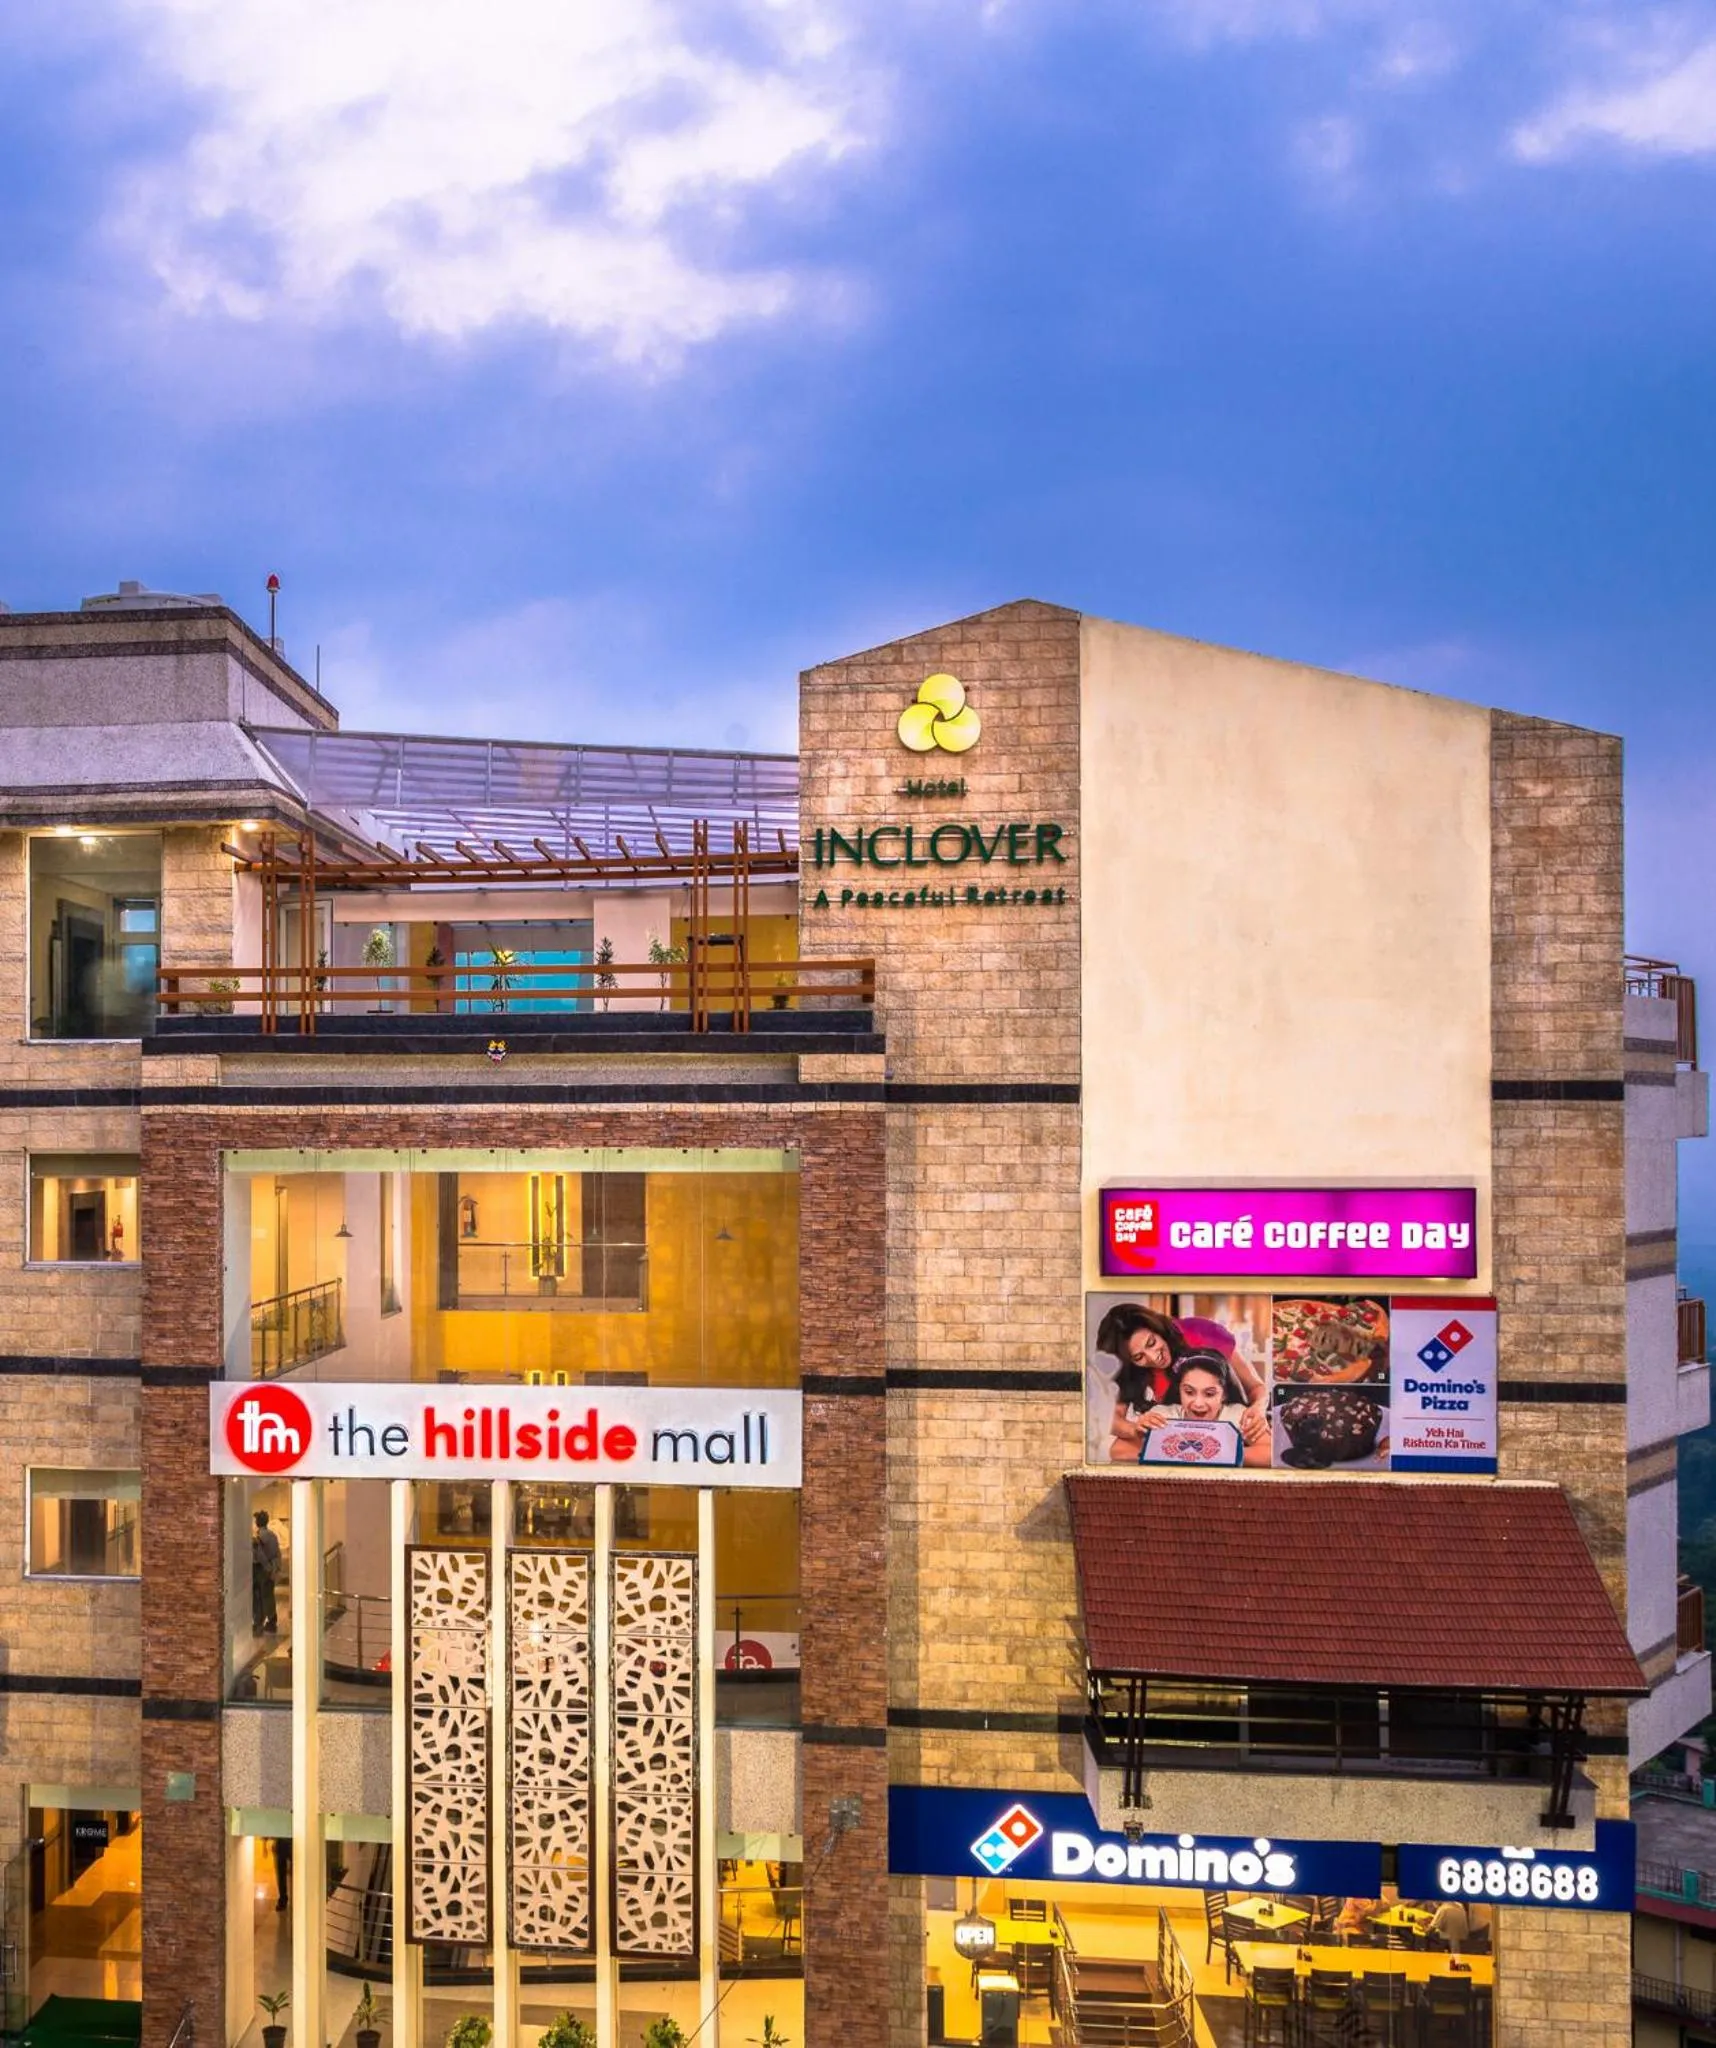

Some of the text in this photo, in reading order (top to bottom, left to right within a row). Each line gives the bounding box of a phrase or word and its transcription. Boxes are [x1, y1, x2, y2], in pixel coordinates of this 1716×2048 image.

[906, 777, 967, 798] Hotel
[815, 823, 1067, 869] INCLOVER
[813, 884, 1067, 908] A Peaceful Retreat
[1404, 1378, 1486, 1394] Domino's
[1421, 1396, 1469, 1411] Pizza
[328, 1405, 769, 1465] the hillside mall
[1403, 1438, 1486, 1449] Rishton Ka Time
[1425, 1428, 1464, 1438] Yeh Hai
[1052, 1832, 1298, 1887] Domino's
[1438, 1859, 1599, 1901] 6888688
[955, 1926, 994, 1945] OPEN
